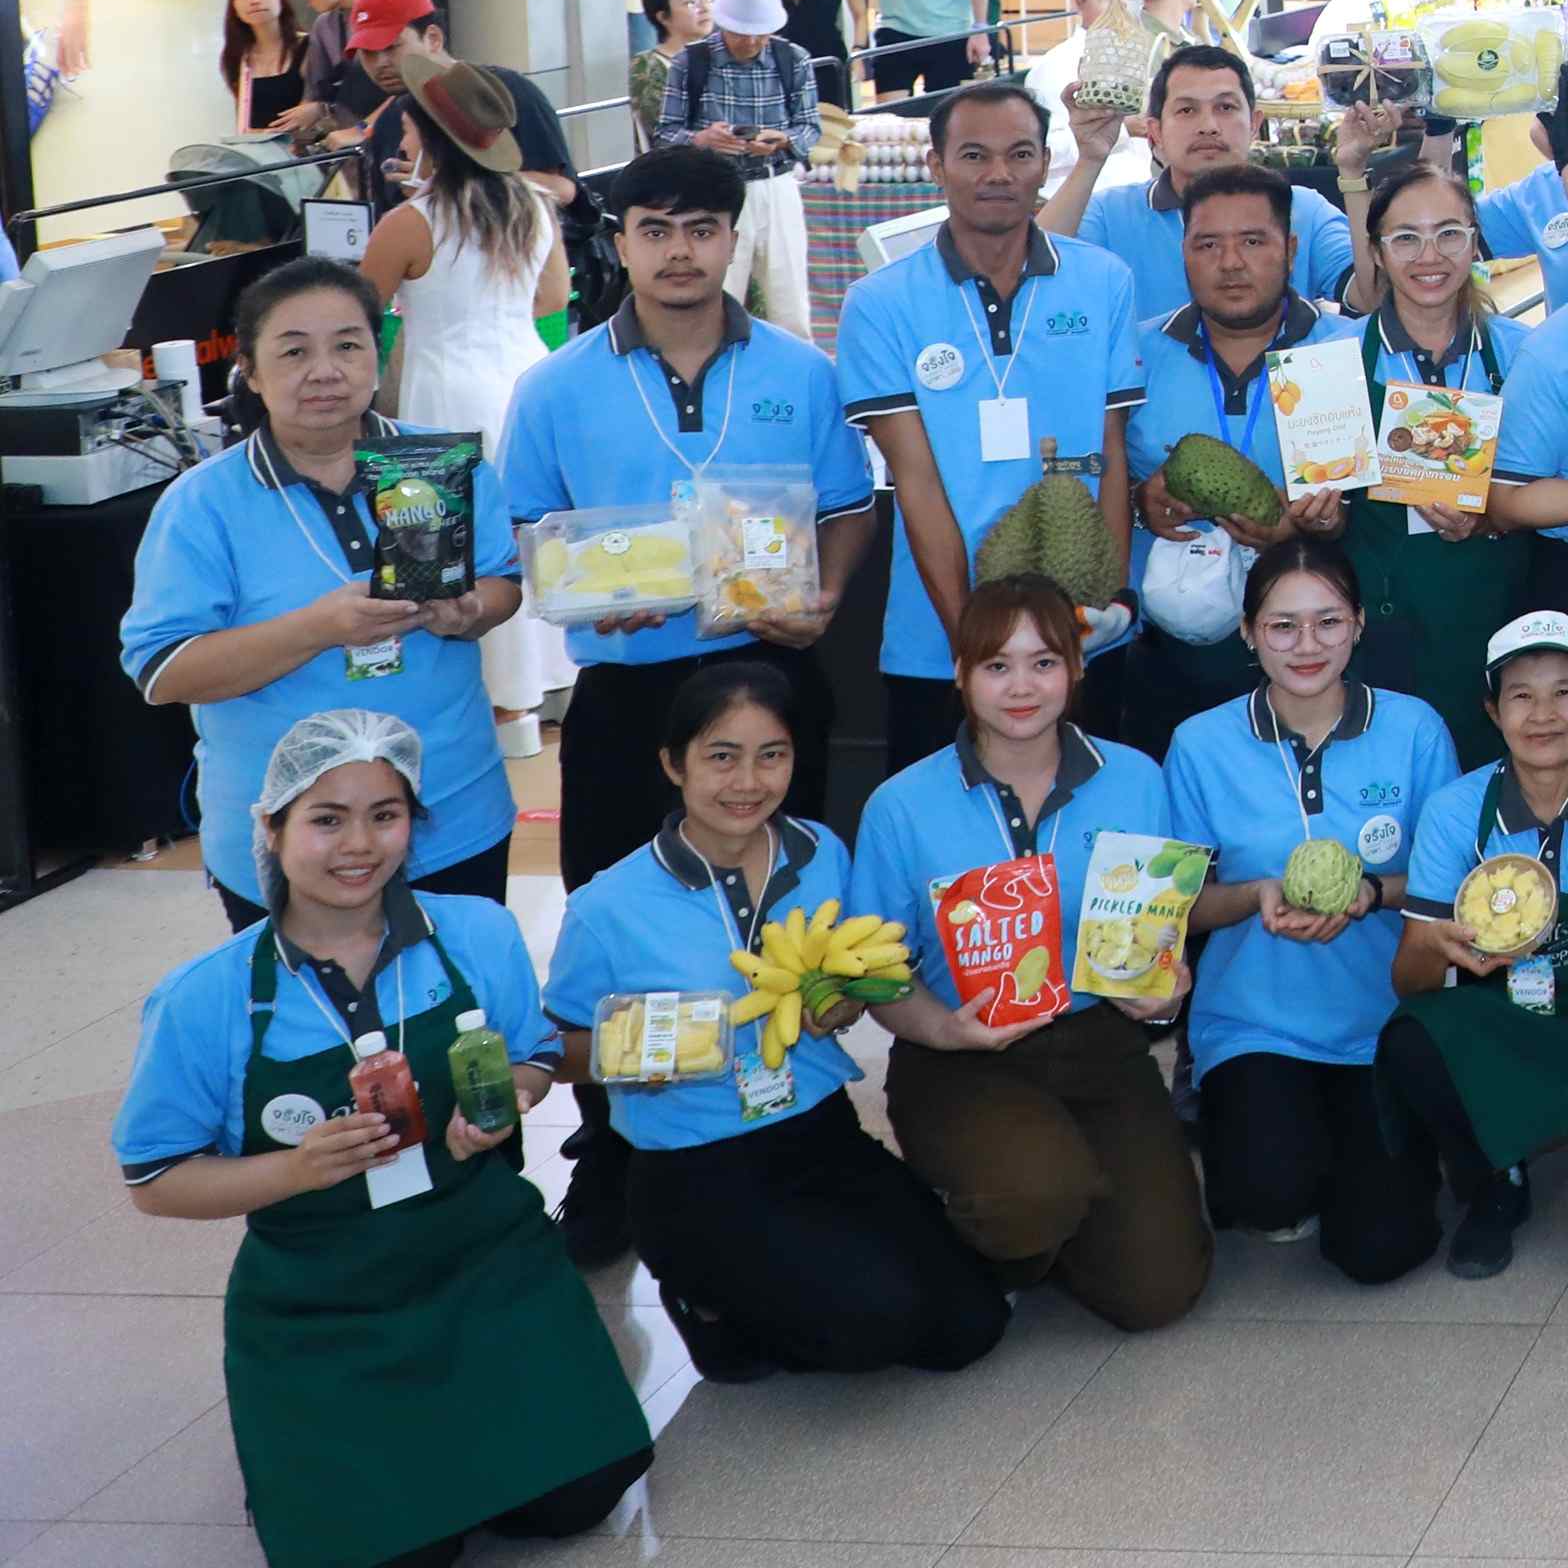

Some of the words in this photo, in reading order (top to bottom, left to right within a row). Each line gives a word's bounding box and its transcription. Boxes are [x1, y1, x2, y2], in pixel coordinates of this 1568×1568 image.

[346, 228, 358, 246] 6
[1089, 894, 1143, 916] PICKLED
[954, 910, 1044, 951] SALTED
[957, 942, 1013, 969] MANGO
